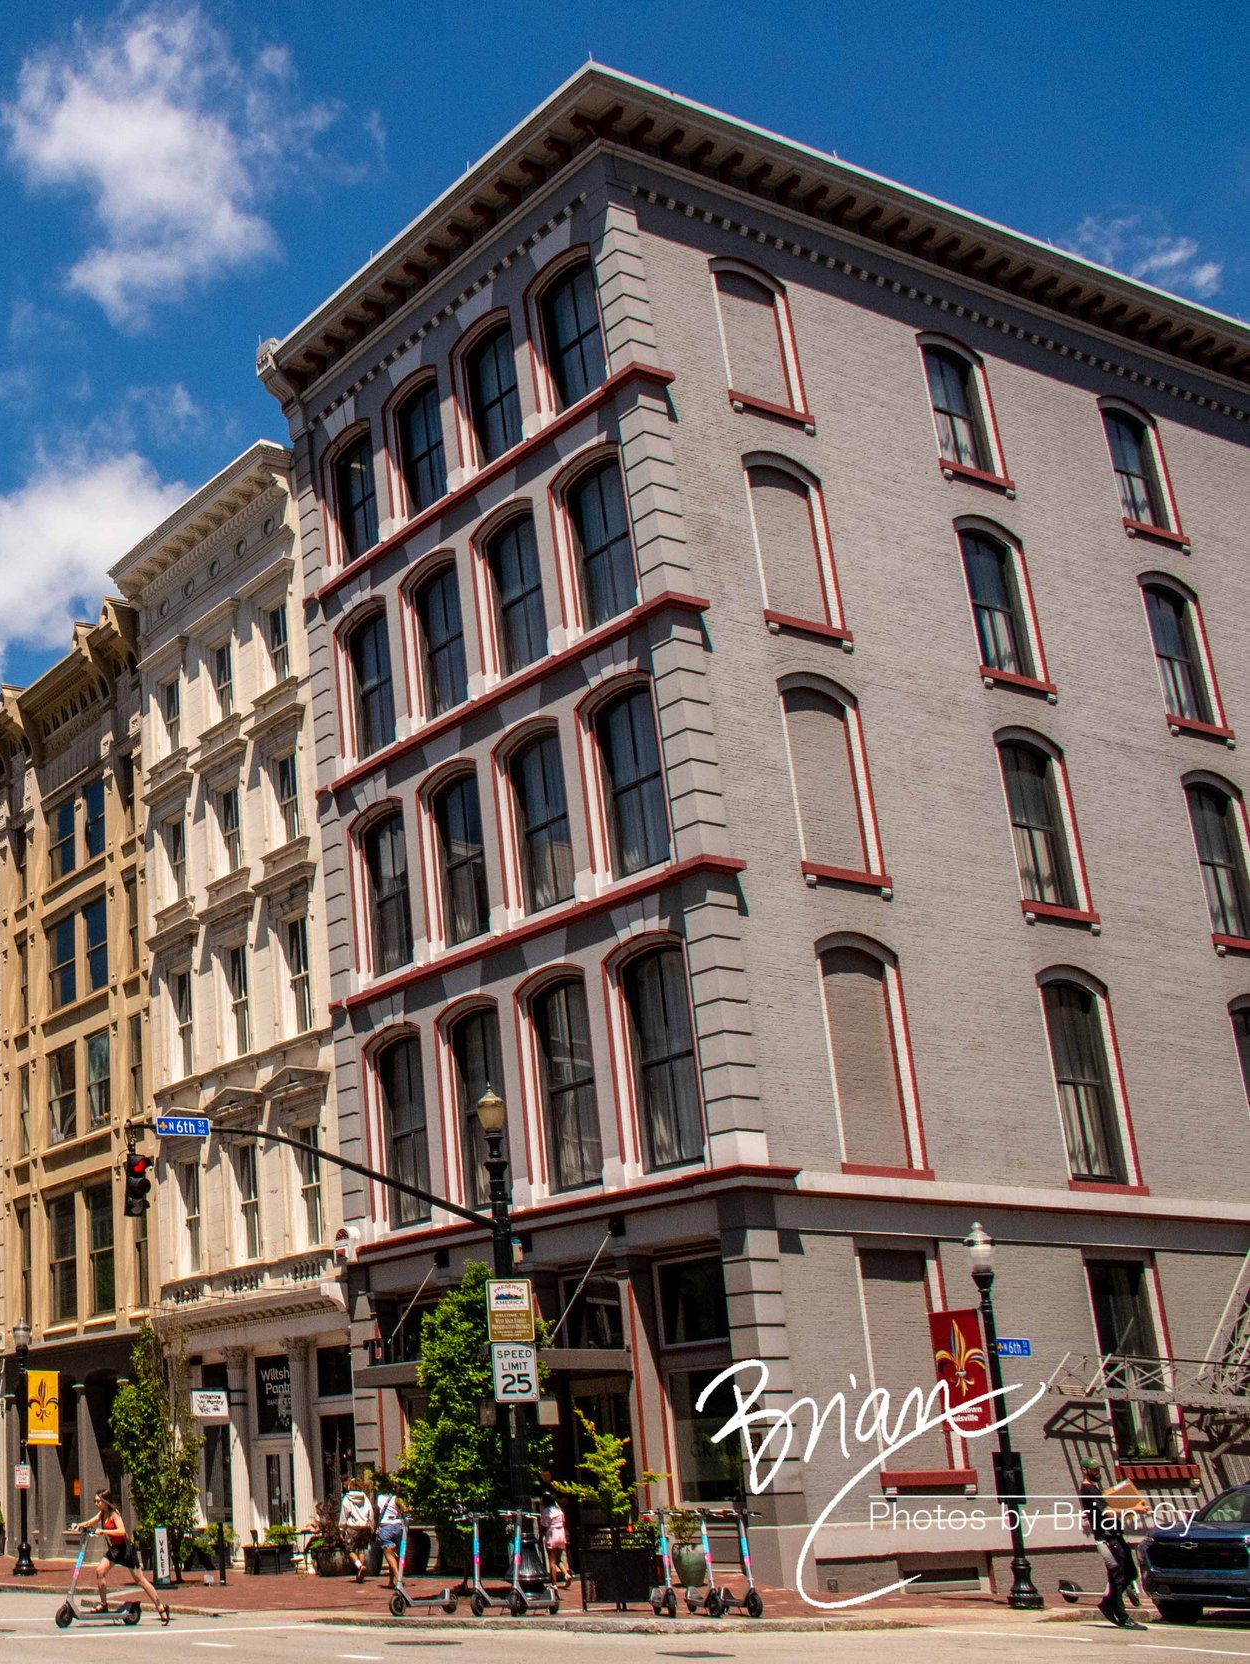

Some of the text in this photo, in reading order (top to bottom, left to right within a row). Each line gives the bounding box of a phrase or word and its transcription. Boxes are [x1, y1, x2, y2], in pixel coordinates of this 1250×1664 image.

[168, 1120, 205, 1133] N 6th St
[493, 1284, 524, 1294] PRESERVE
[1008, 1341, 1022, 1354] 6th
[496, 1349, 532, 1359] SPEED
[502, 1361, 528, 1371] LIMIT
[501, 1373, 532, 1395] 25
